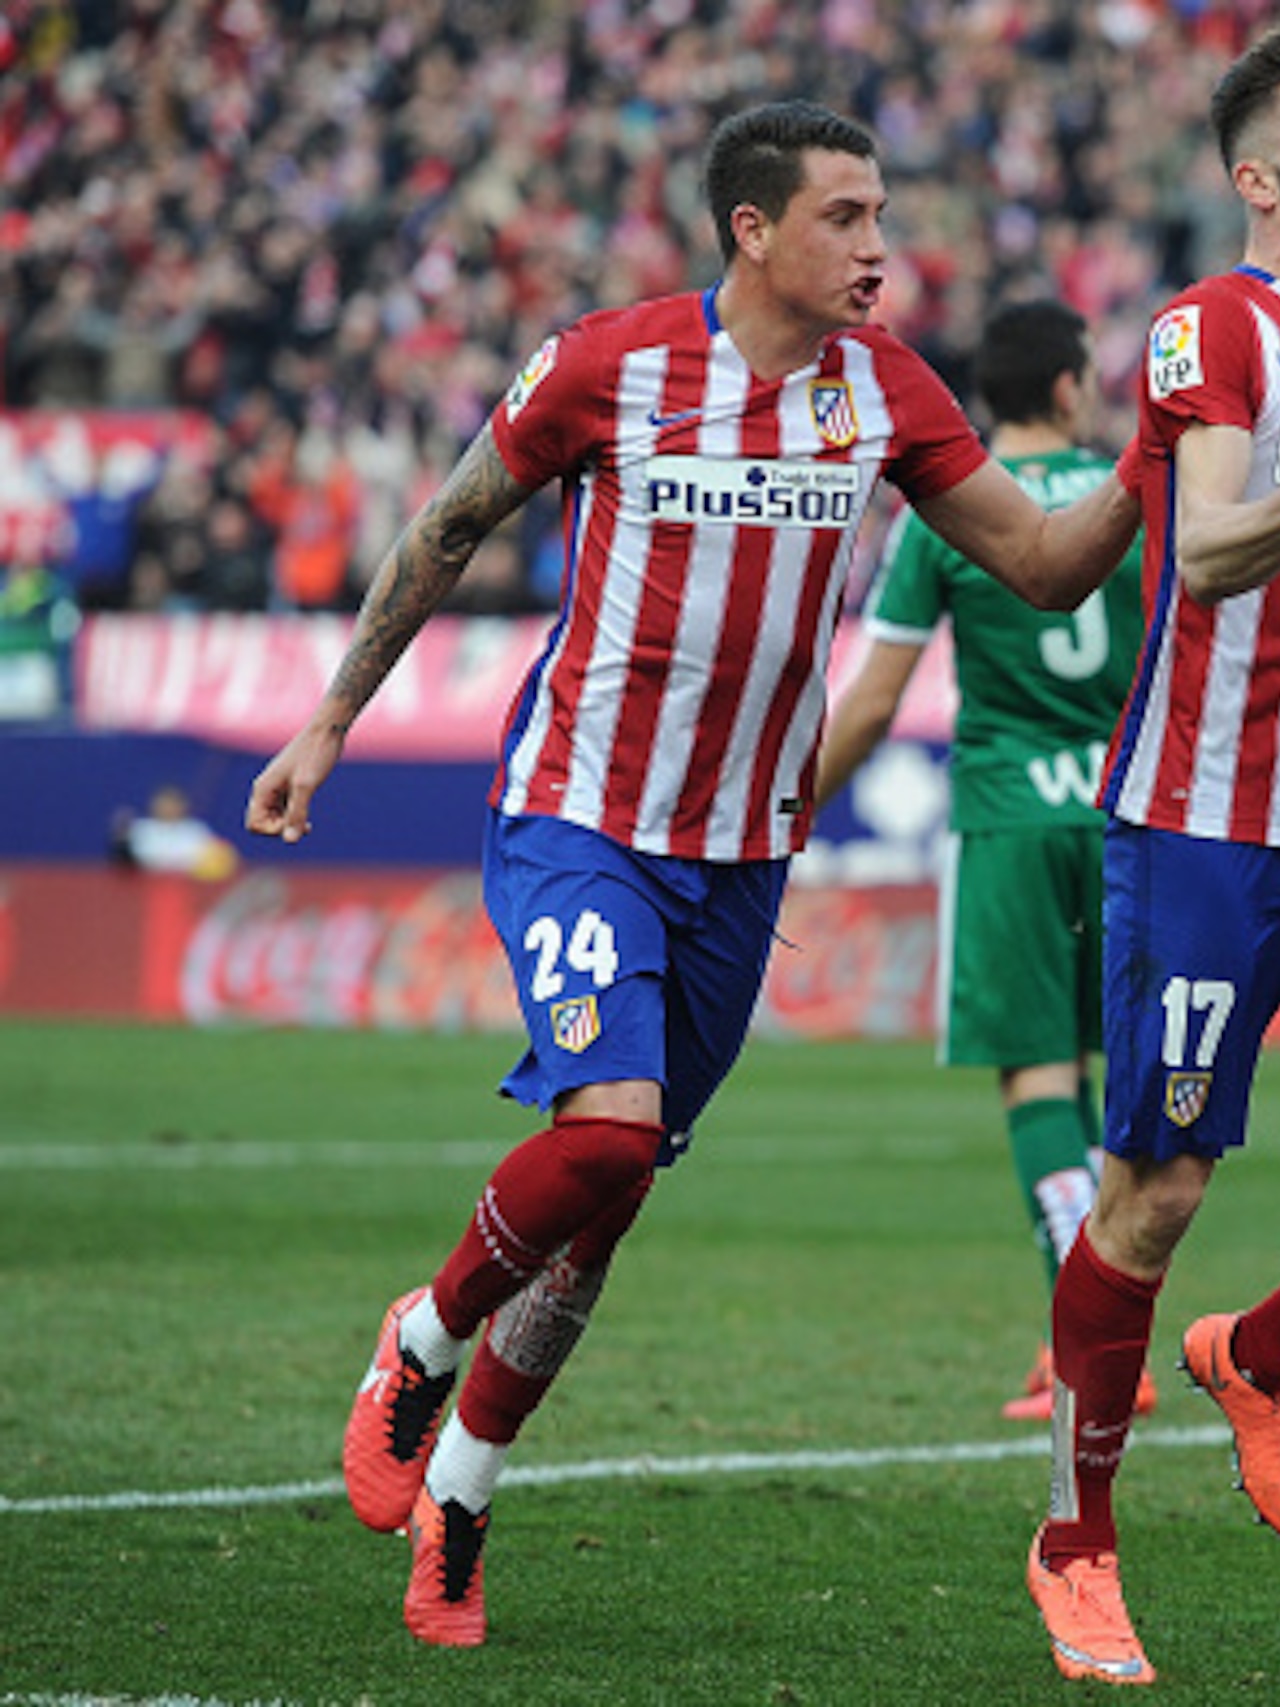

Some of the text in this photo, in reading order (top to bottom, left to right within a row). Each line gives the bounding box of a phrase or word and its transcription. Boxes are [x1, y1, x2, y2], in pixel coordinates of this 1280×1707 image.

[650, 480, 852, 521] Plus500
[523, 909, 619, 1003] 24
[1161, 972, 1236, 1068] 17
